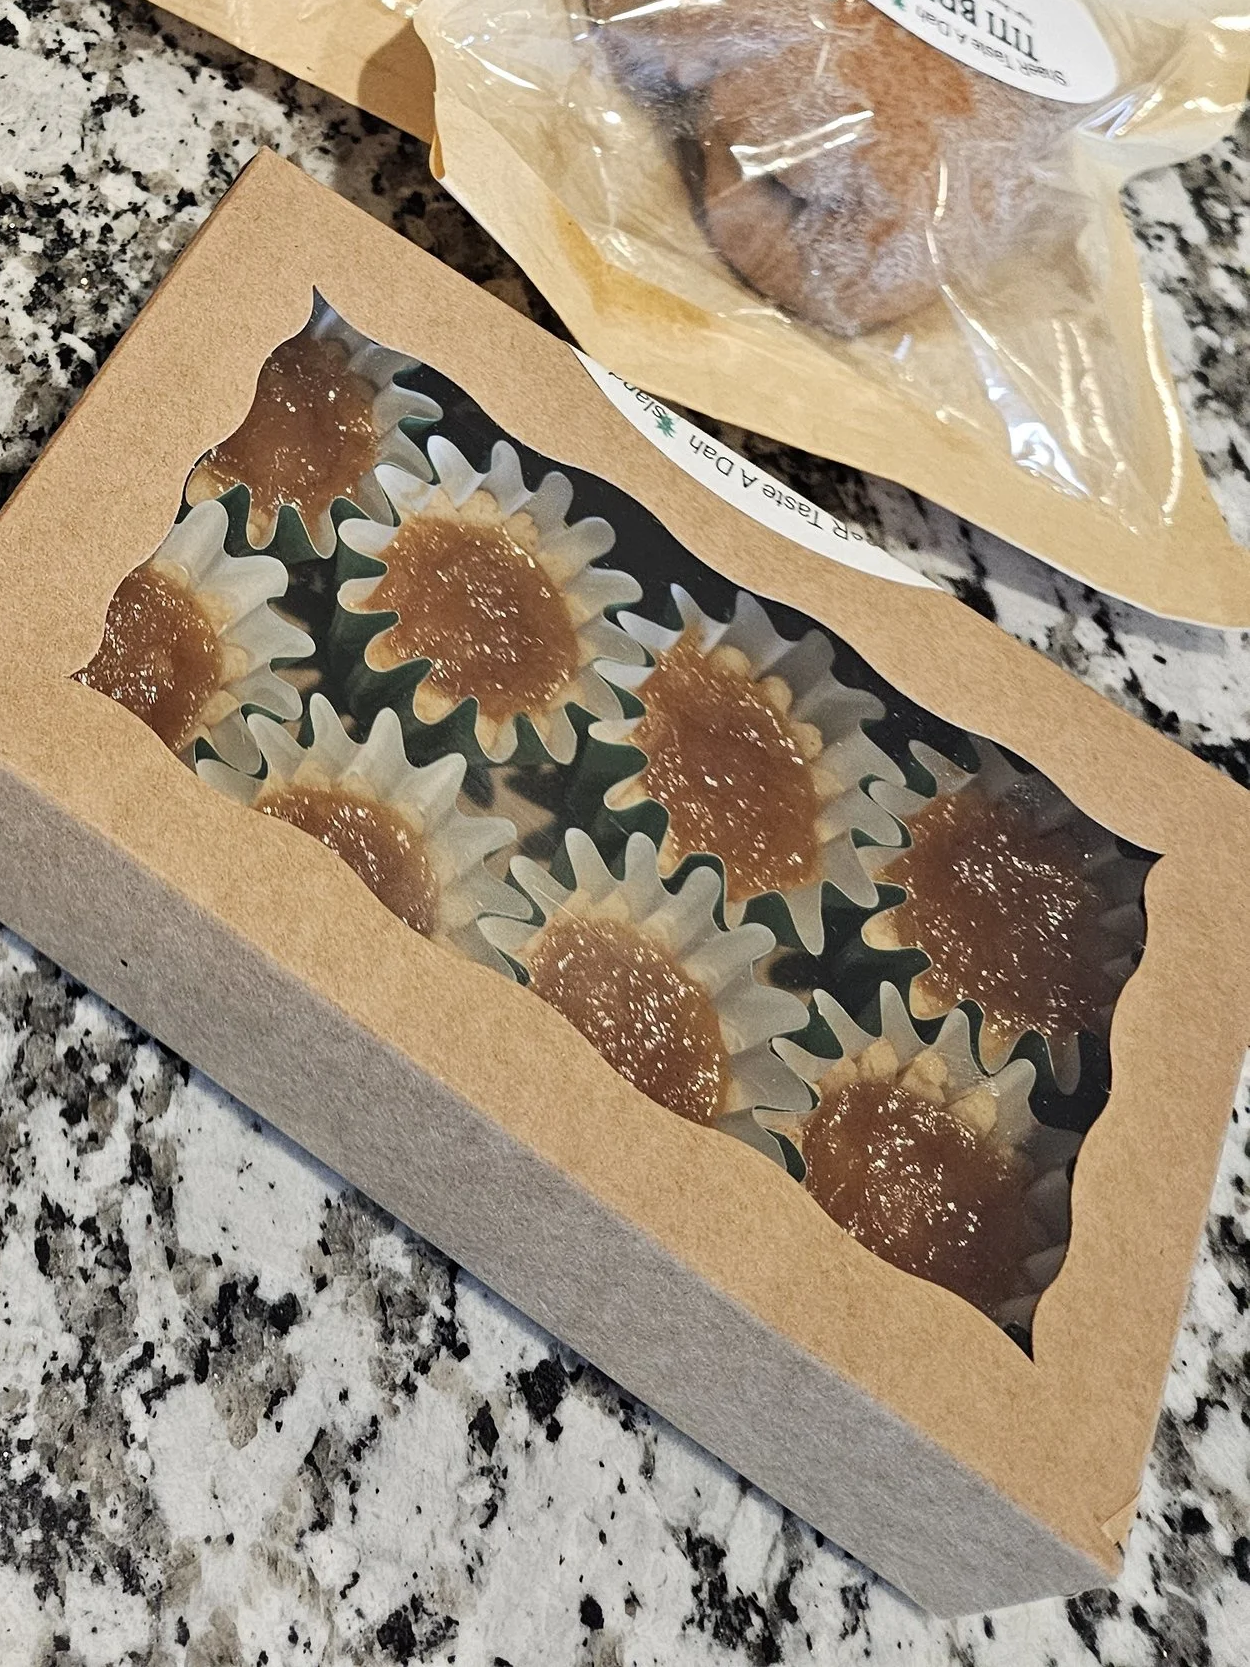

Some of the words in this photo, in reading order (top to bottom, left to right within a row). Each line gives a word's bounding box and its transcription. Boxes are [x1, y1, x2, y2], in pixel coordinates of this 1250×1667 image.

[915, 4, 950, 37] Dah
[954, 28, 968, 44] A
[986, 9, 1038, 62] TITI
[971, 38, 1014, 71] Taste
[689, 433, 735, 477] Dah
[741, 466, 758, 488] A
[762, 486, 823, 529] Taste
